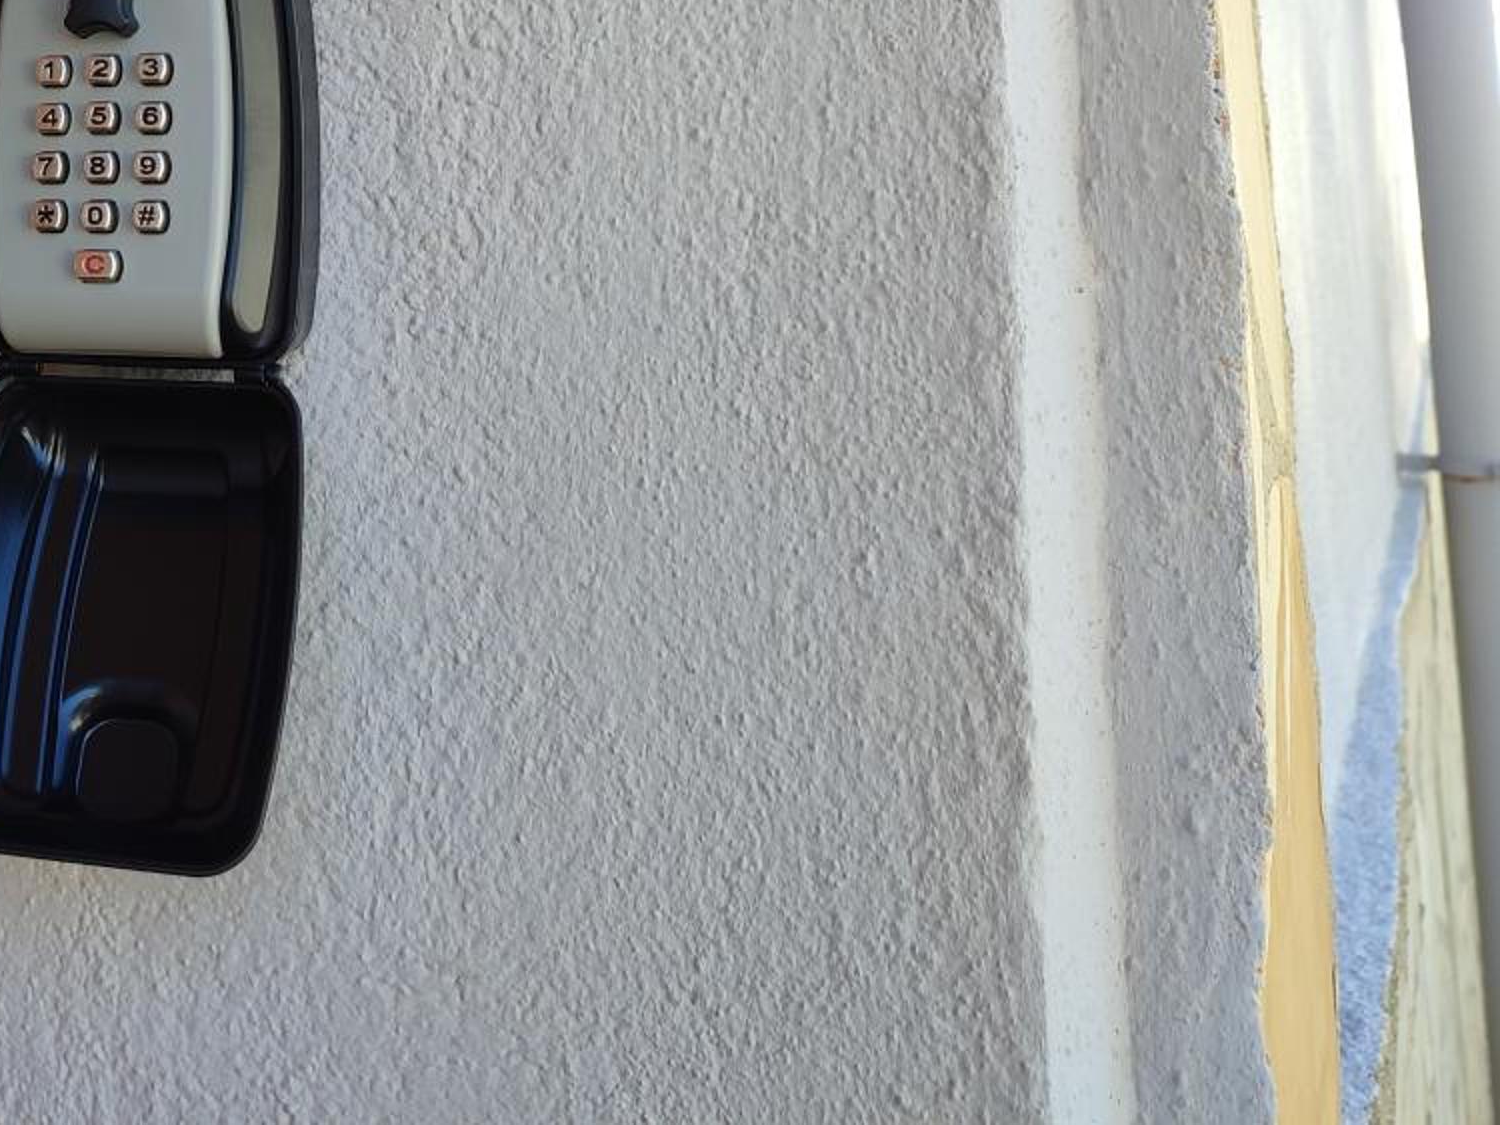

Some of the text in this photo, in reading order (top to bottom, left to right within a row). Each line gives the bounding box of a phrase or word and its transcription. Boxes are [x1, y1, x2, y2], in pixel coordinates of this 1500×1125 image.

[43, 57, 159, 79] 1 2 3
[41, 106, 159, 127] 4 5 6
[37, 156, 157, 176] 7 8 9
[87, 206, 103, 225] 0
[137, 205, 156, 226] #
[85, 255, 105, 274] C
